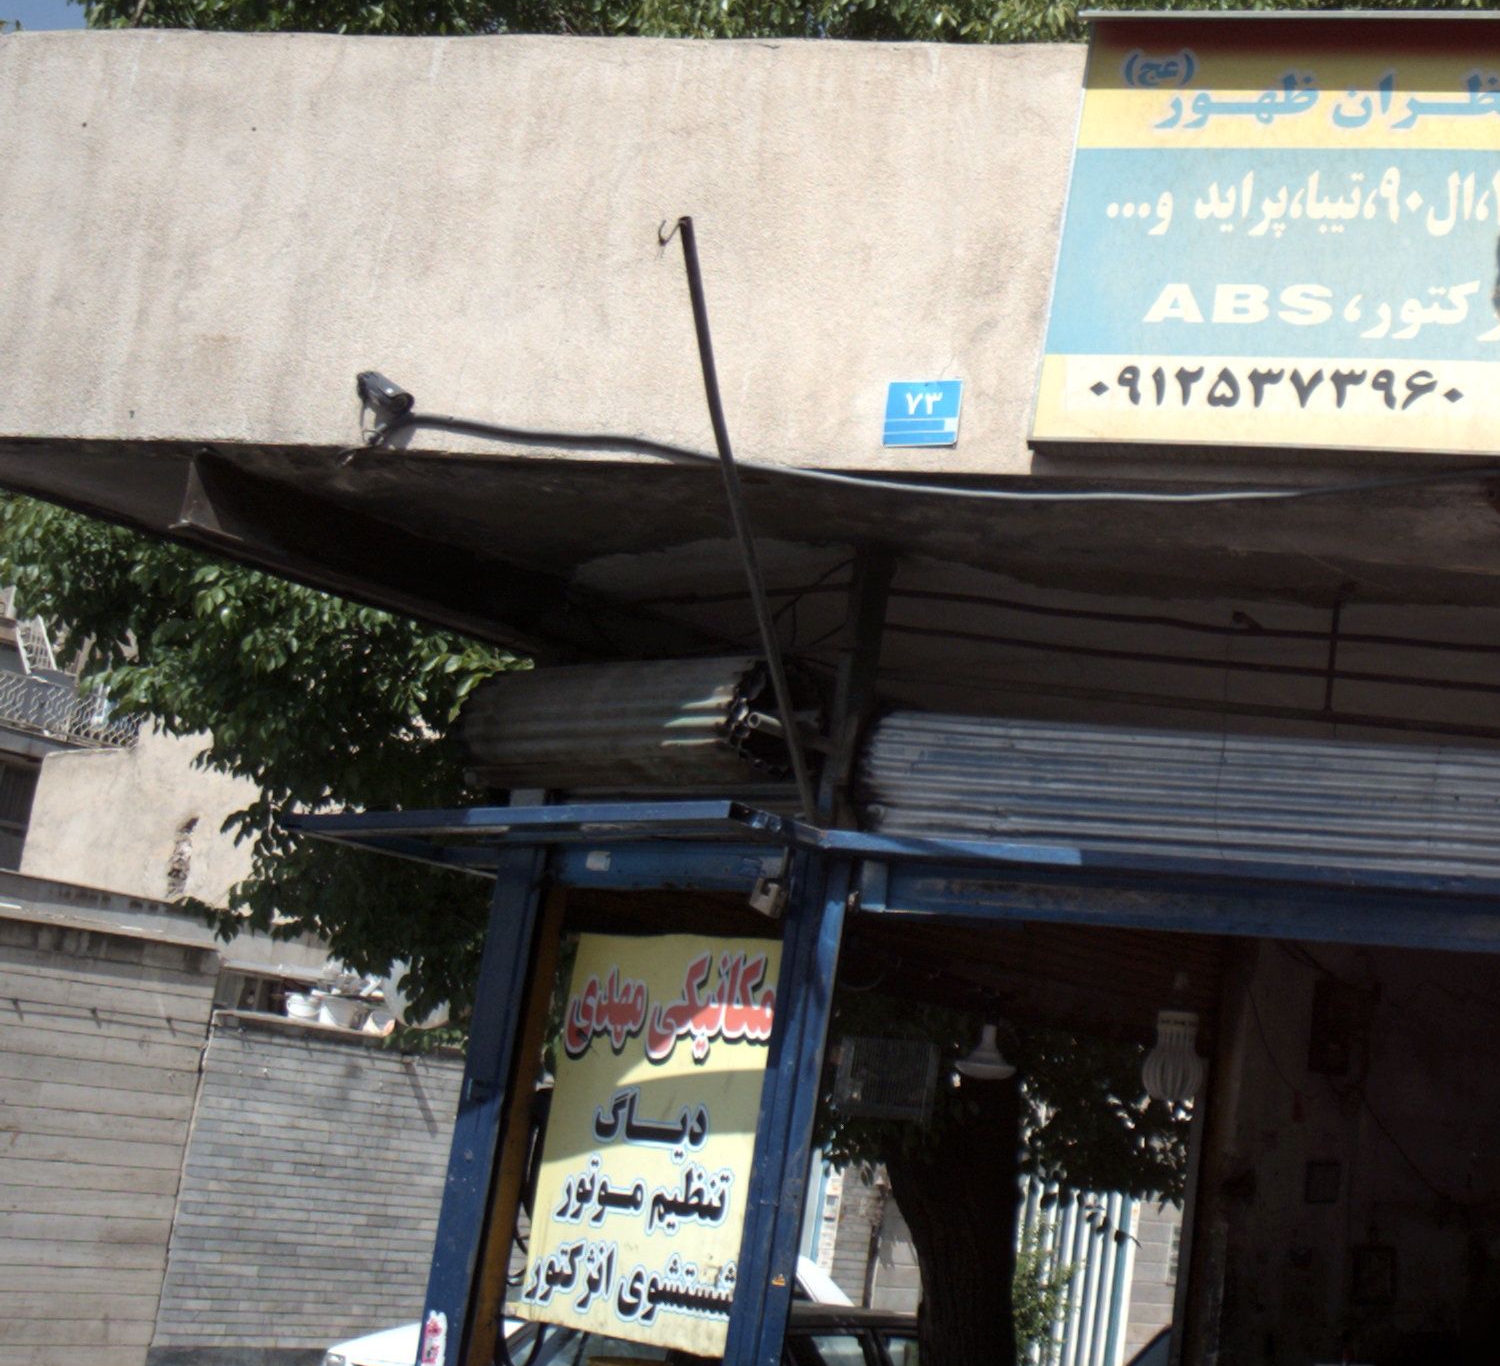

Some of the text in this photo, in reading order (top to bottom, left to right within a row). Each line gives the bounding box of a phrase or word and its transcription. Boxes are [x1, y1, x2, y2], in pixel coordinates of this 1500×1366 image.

[1153, 73, 1319, 130] ظهور
[1142, 283, 1334, 325] ABS
[1088, 364, 1465, 411] ۰۹۱۲۵۳۷۳۹۶۰
[565, 951, 776, 1061] مکانیکی مهدی
[595, 1091, 708, 1158] دیاگ
[556, 1158, 731, 1231] تنظیم موتور
[525, 1241, 737, 1322] شستشوی انژکتور
